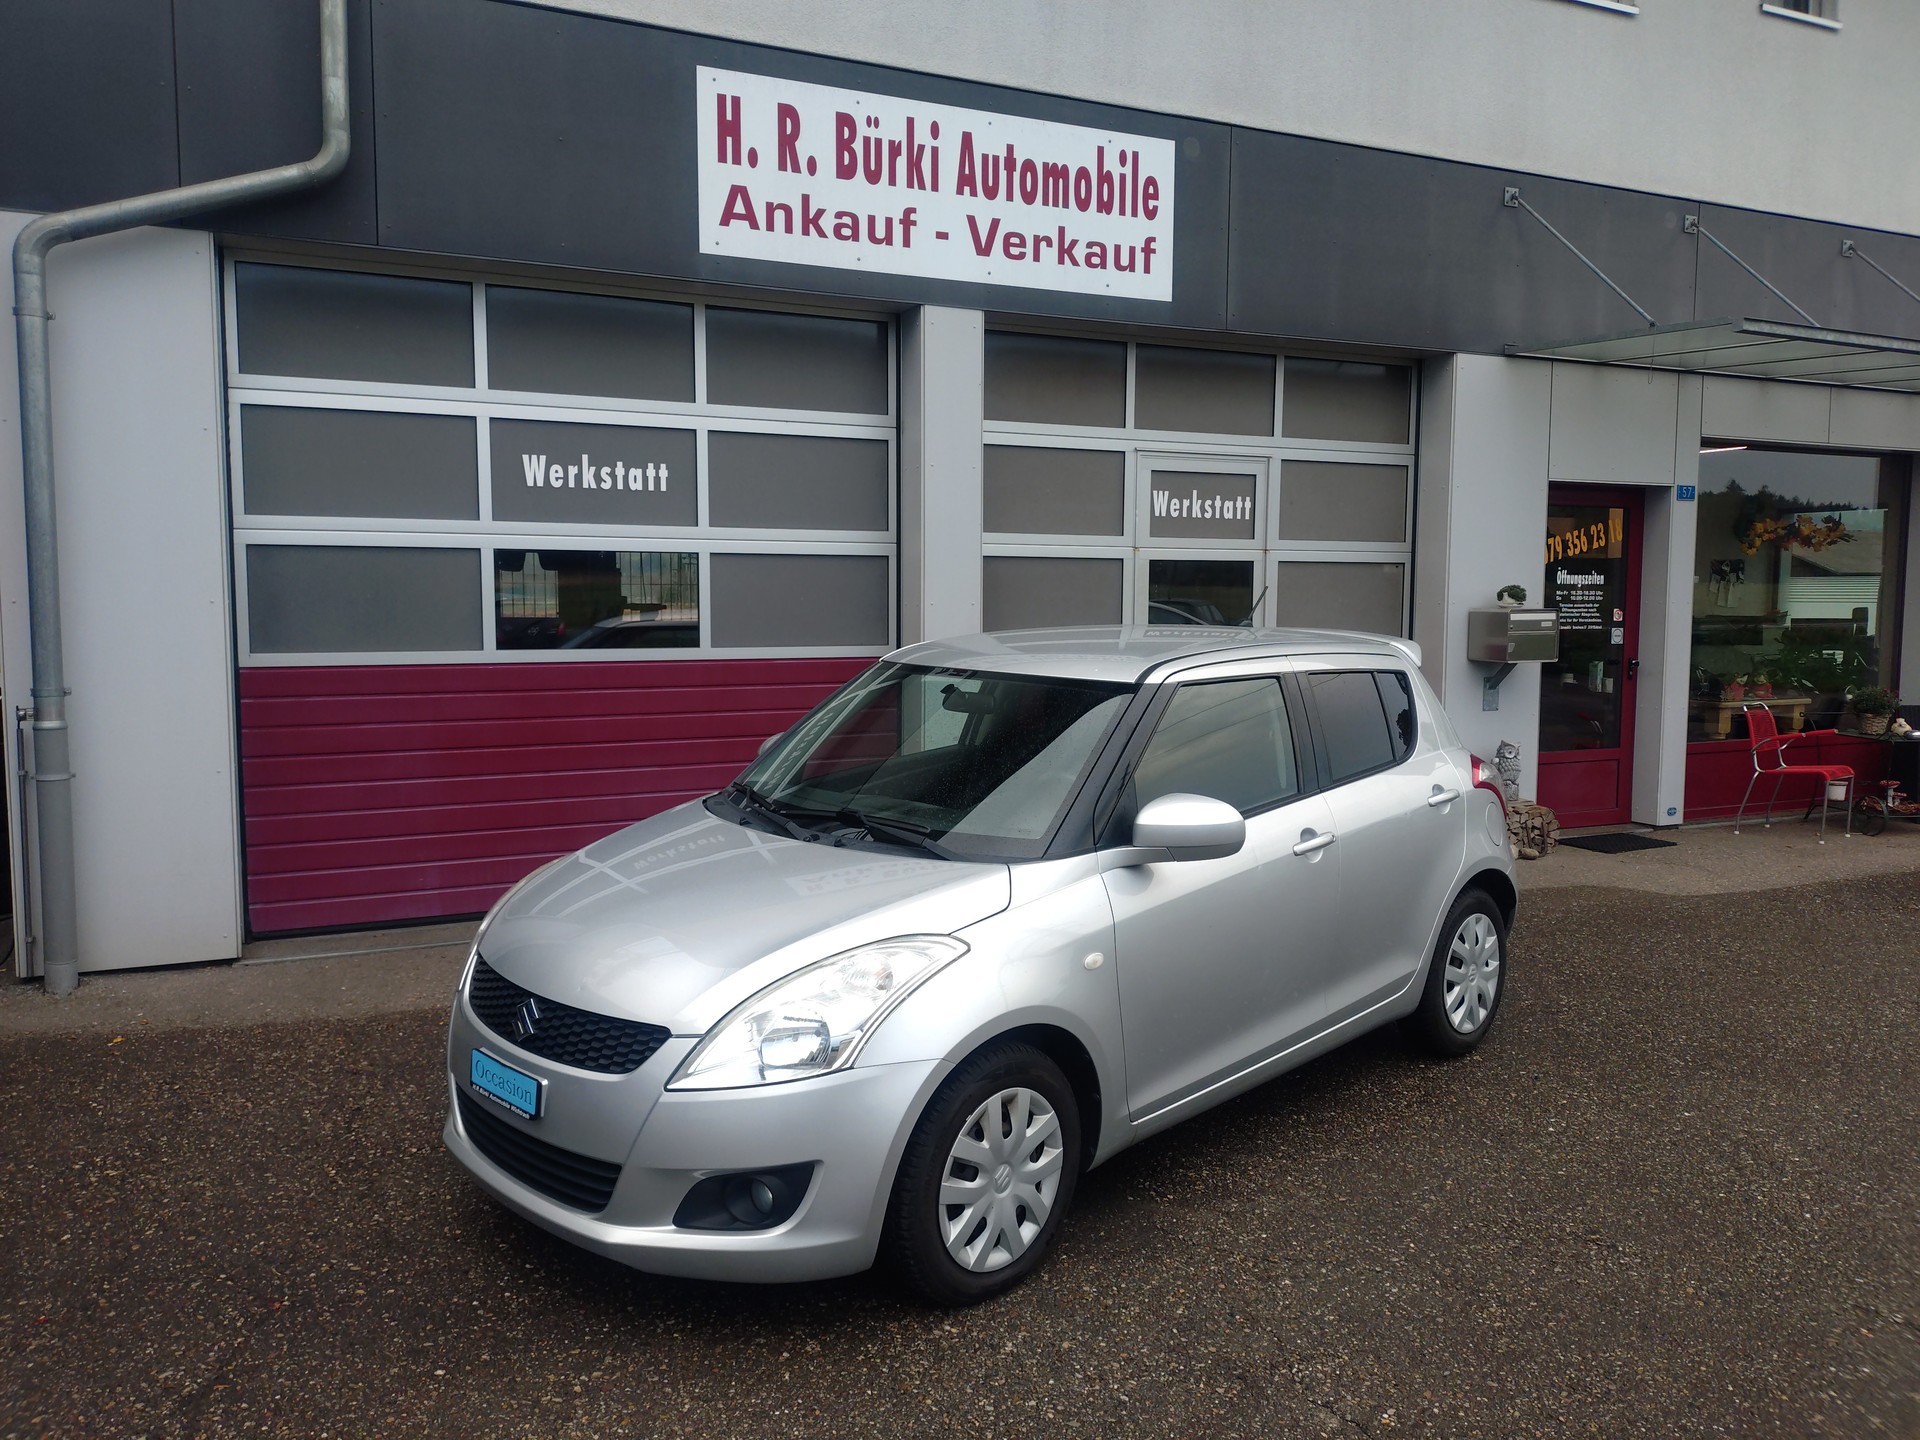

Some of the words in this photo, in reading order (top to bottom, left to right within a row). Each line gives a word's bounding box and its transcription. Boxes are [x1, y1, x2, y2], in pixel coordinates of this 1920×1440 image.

[717, 94, 758, 168] H.
[777, 103, 817, 177] R.
[835, 112, 939, 193] Bürki
[956, 131, 1160, 221] Automobile
[718, 185, 917, 249] Ankauf
[935, 231, 950, 242] -
[966, 214, 1157, 275] Verkauf
[522, 454, 669, 492] Werkstatt
[1152, 489, 1252, 520] Werkstatt
[1682, 487, 1692, 498] 57
[1565, 527, 1588, 557] 356
[1590, 522, 1606, 549] 23
[1608, 519, 1623, 543] 18
[1556, 567, 1605, 587] Öffnungszeiten
[475, 1059, 533, 1105] Occasion
